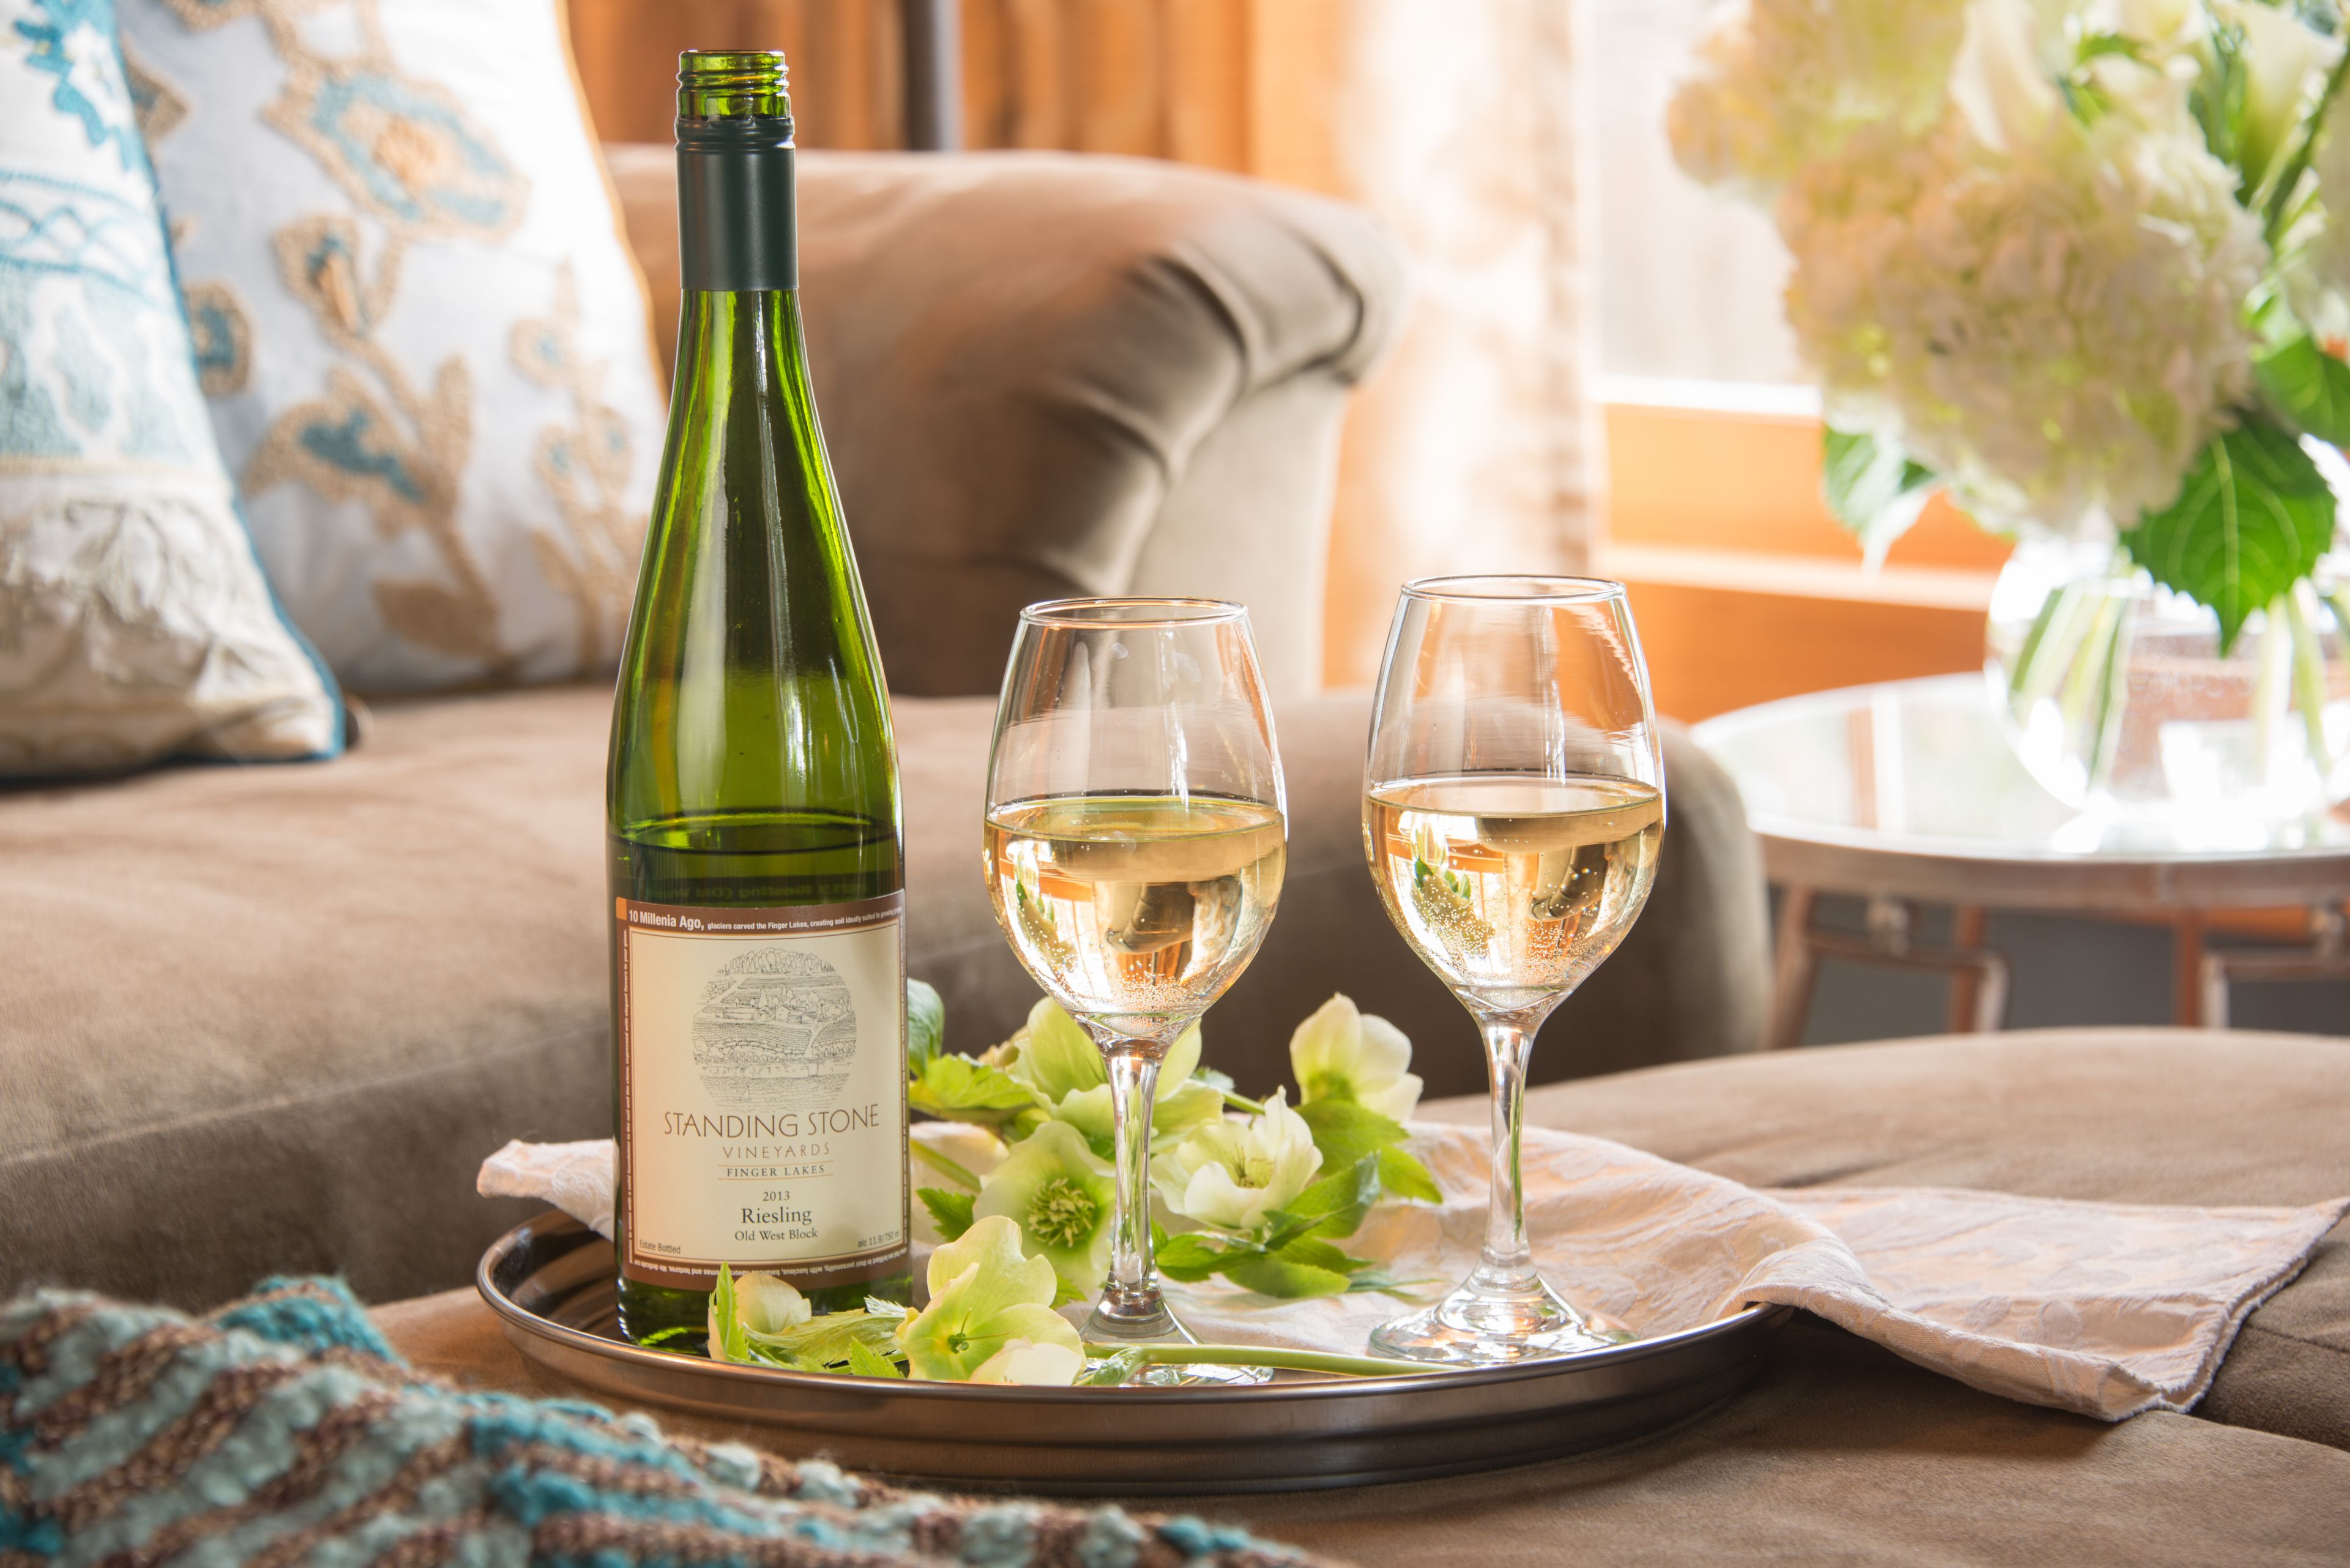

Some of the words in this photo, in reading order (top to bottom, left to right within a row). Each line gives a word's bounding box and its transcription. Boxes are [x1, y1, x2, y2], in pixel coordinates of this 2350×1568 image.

[629, 909, 638, 923] 10
[640, 911, 677, 927] Millenia
[679, 915, 704, 931] Ago,
[845, 915, 861, 924] ideally
[862, 913, 876, 921] suited
[665, 1112, 797, 1138] STANDING
[808, 1104, 879, 1135] STONE
[723, 1143, 829, 1159] VINEYARDS
[785, 1165, 825, 1175] LAKES
[763, 1191, 789, 1201] 2013
[742, 1207, 811, 1225] Riesling
[735, 1231, 755, 1241] Old
[759, 1230, 786, 1241] West
[789, 1228, 818, 1239] Block
[640, 1239, 656, 1250] Estate
[658, 1243, 681, 1254] Bottled
[857, 1239, 867, 1248] alc
[659, 1264, 667, 1273] We
[668, 1266, 691, 1275] textures.
[824, 1261, 855, 1272] personality,
